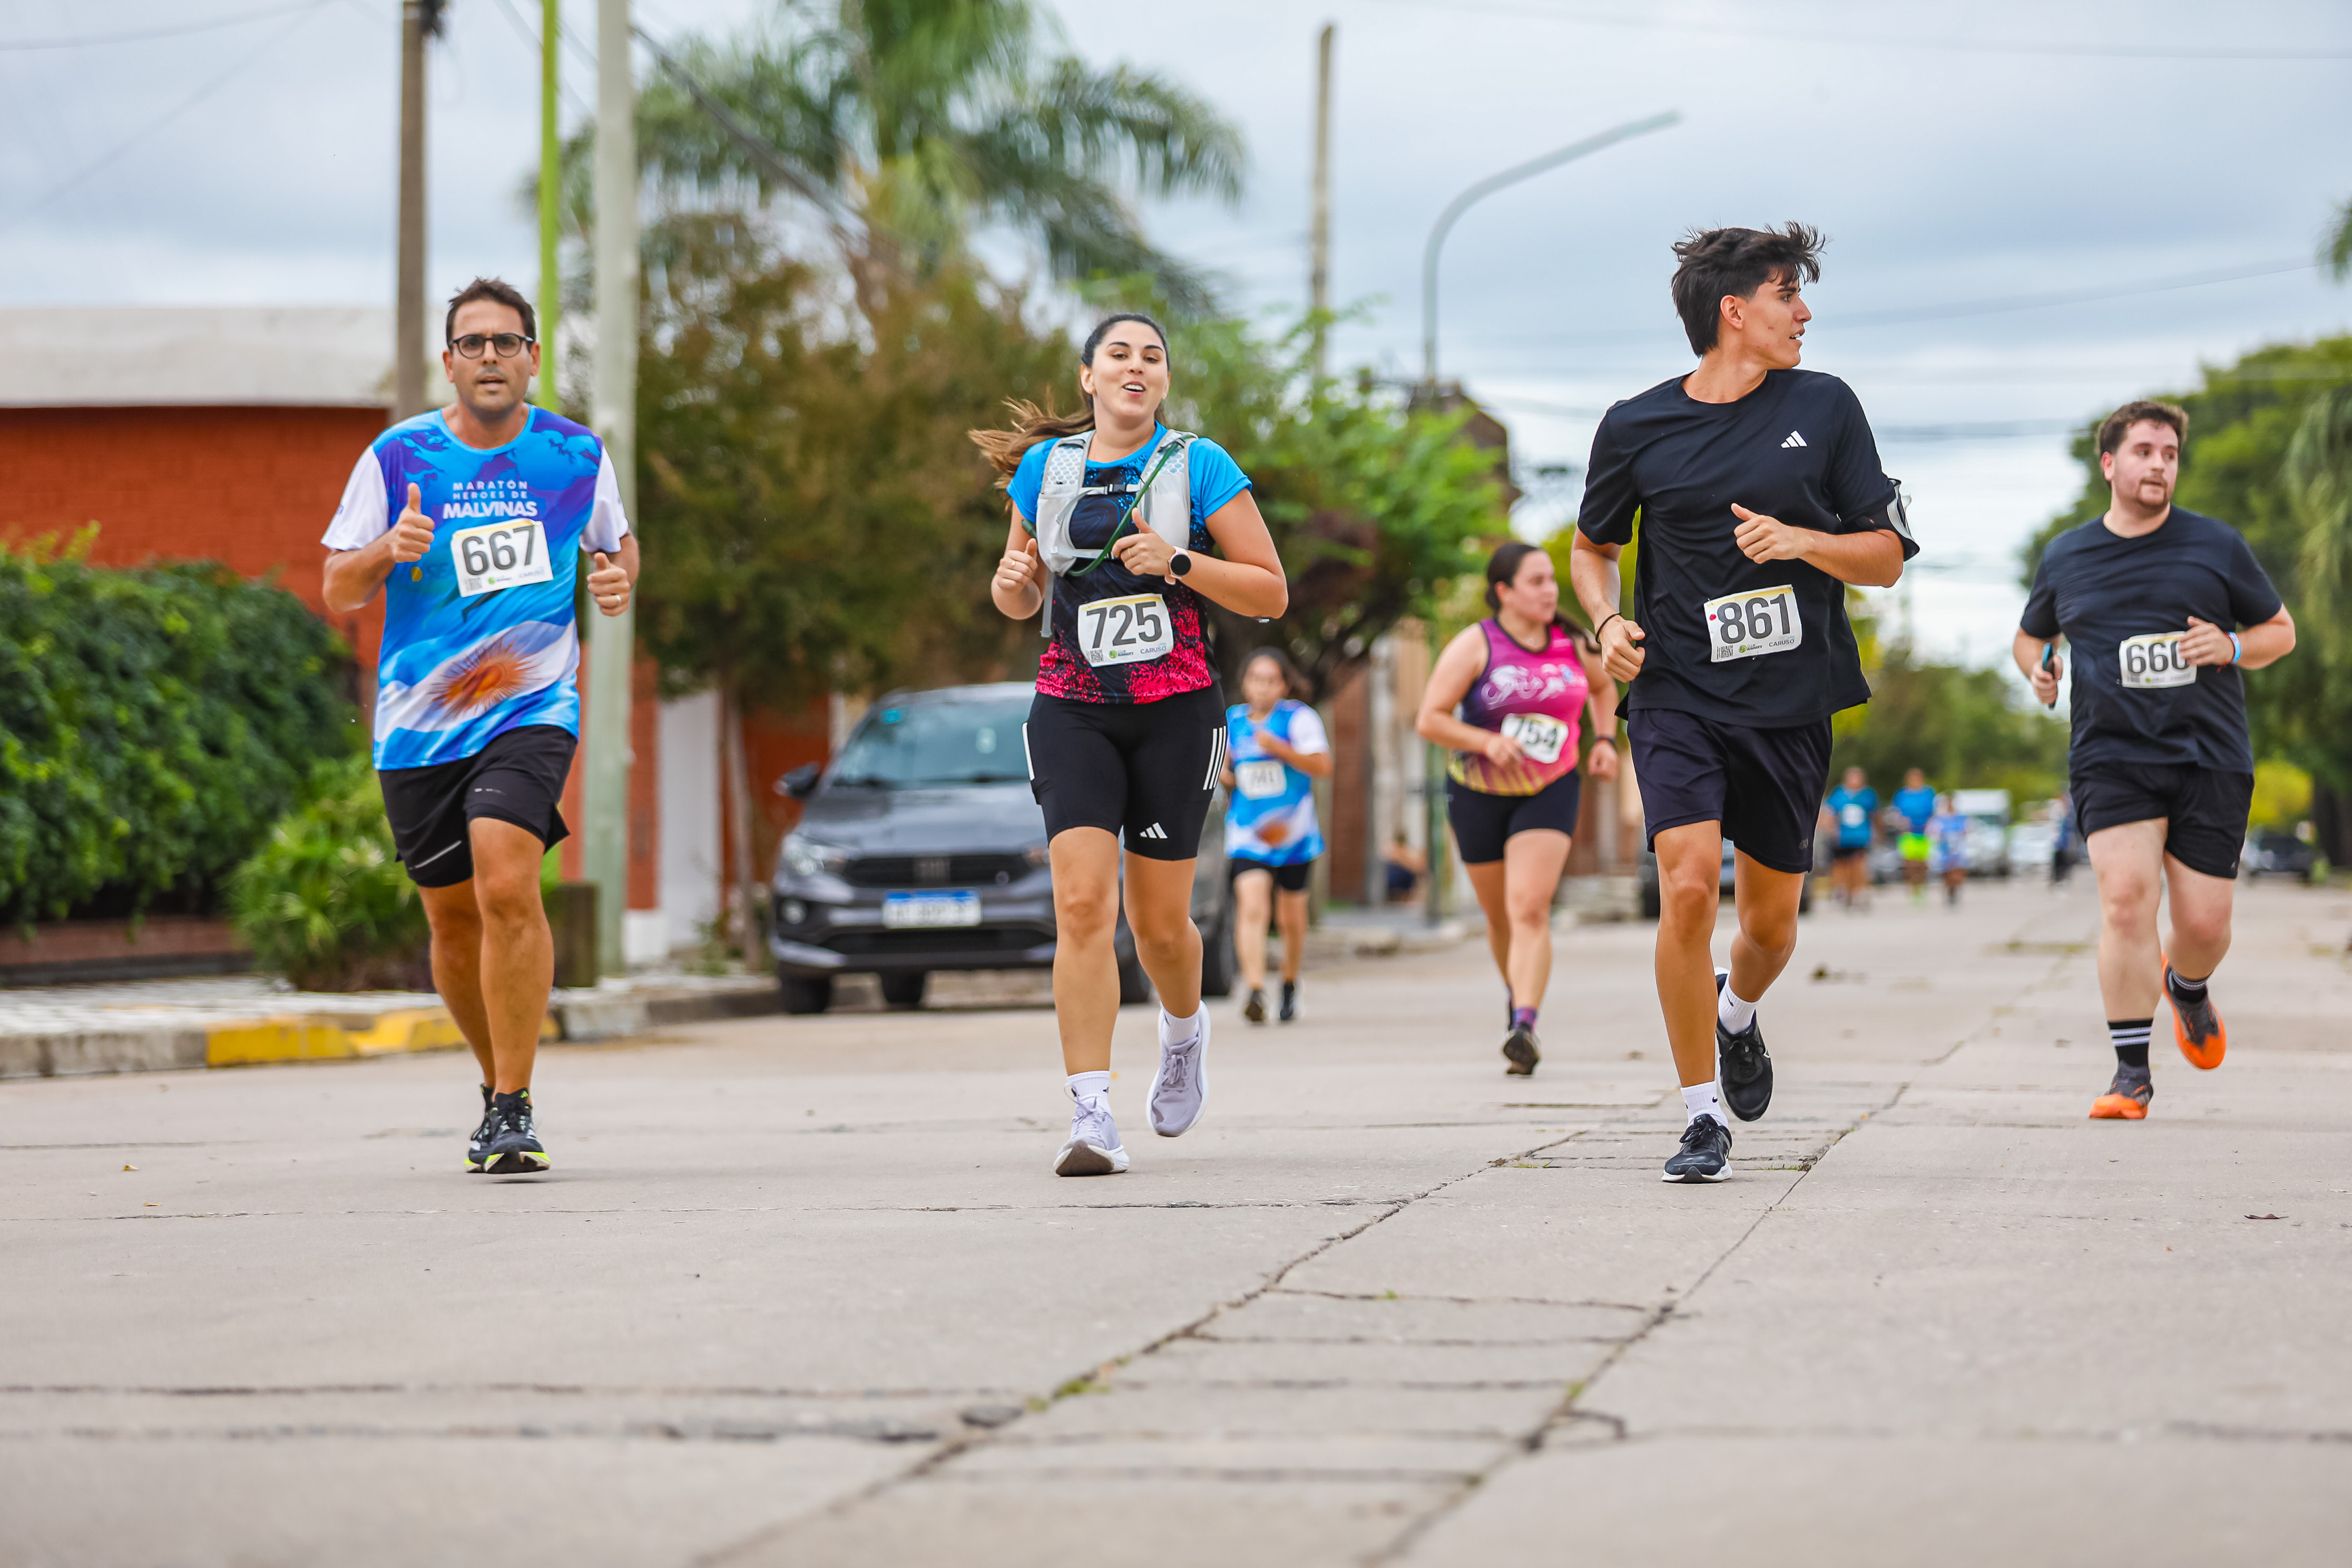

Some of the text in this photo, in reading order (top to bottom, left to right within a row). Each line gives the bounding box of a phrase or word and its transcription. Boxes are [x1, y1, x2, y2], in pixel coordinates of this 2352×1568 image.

[443, 501, 538, 519] MALVINAS
[511, 491, 527, 499] DE
[462, 525, 535, 575] 667
[1086, 601, 1162, 649] 725
[1717, 593, 1790, 644] 861
